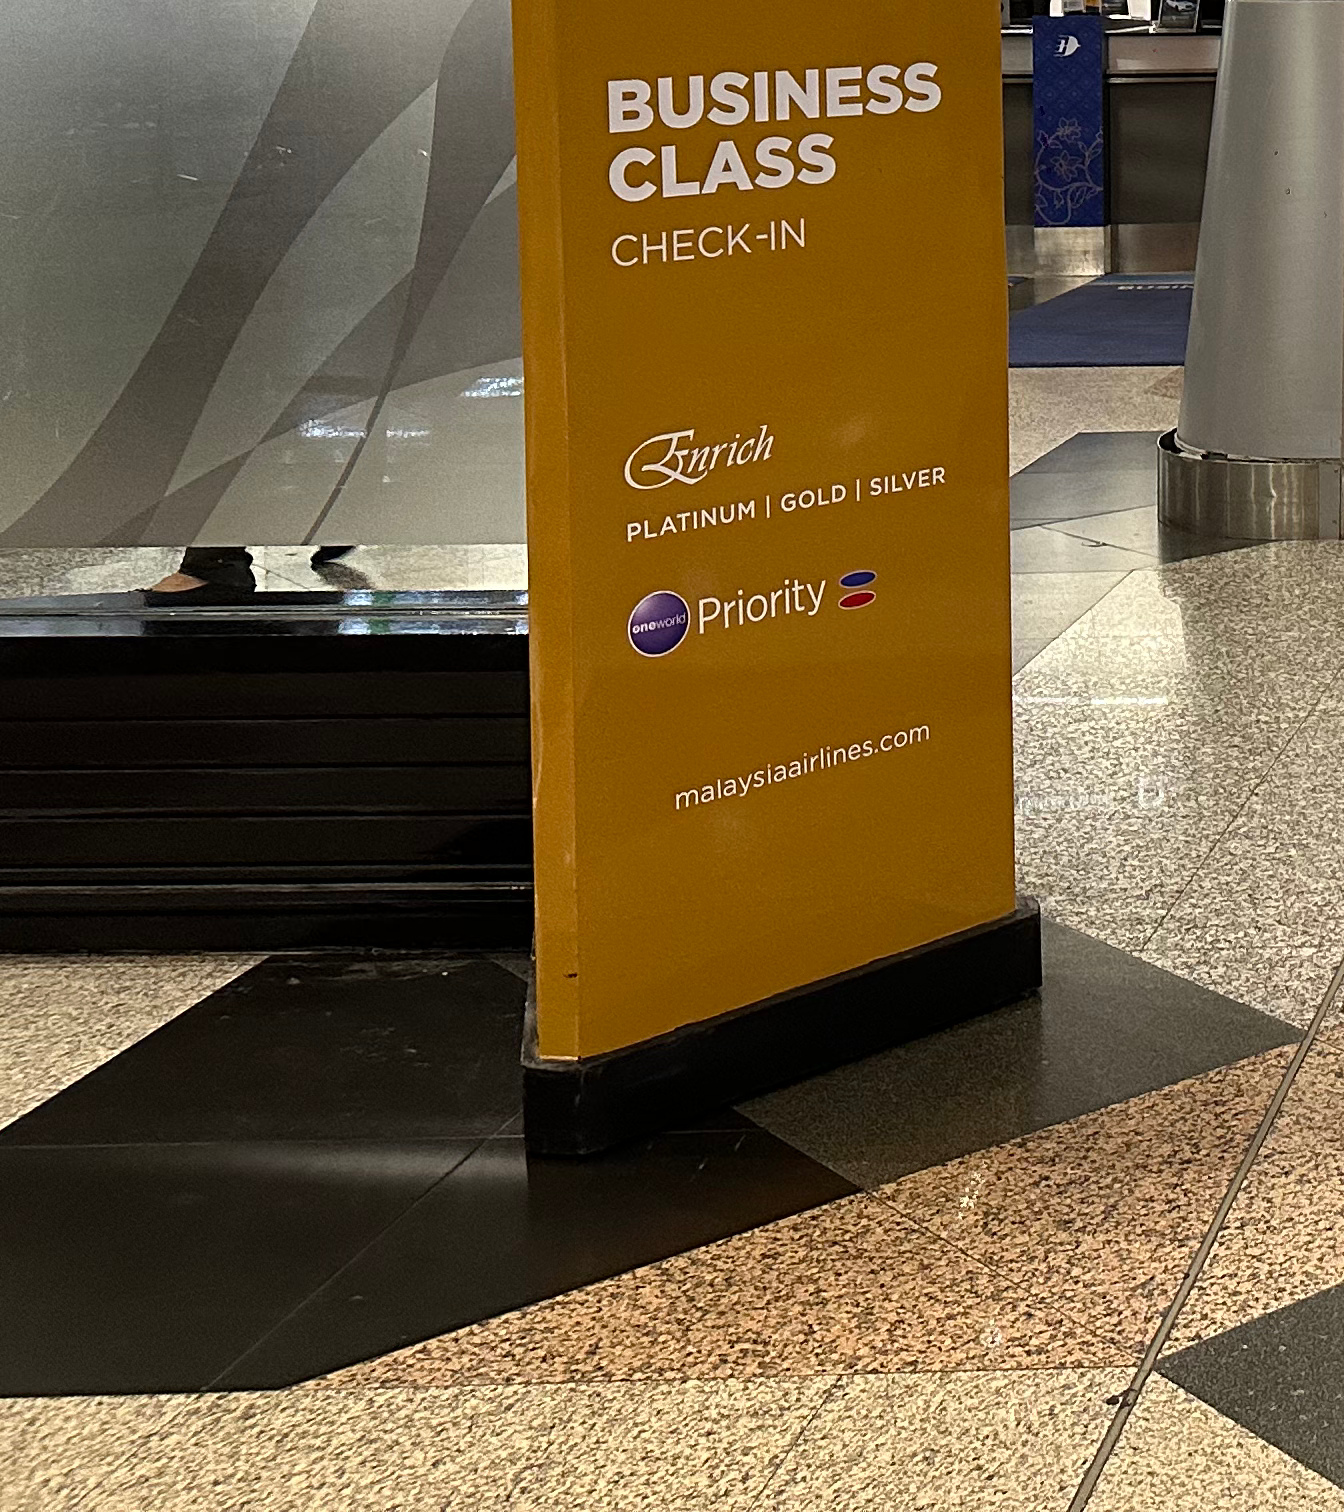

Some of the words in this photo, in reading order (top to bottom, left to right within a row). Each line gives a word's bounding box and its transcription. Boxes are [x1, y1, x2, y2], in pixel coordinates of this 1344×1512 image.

[607, 62, 942, 134] BUSINESS
[608, 133, 836, 202] CLASS
[611, 218, 805, 267] CHECK-IN
[624, 425, 774, 489] Enrich
[627, 500, 756, 543] PLATINUM
[781, 484, 846, 512] GOLD
[870, 467, 946, 497] SILVER
[632, 613, 686, 634] oneworld
[698, 579, 826, 634] Priority
[675, 724, 930, 810] malaysiaairlines.com
